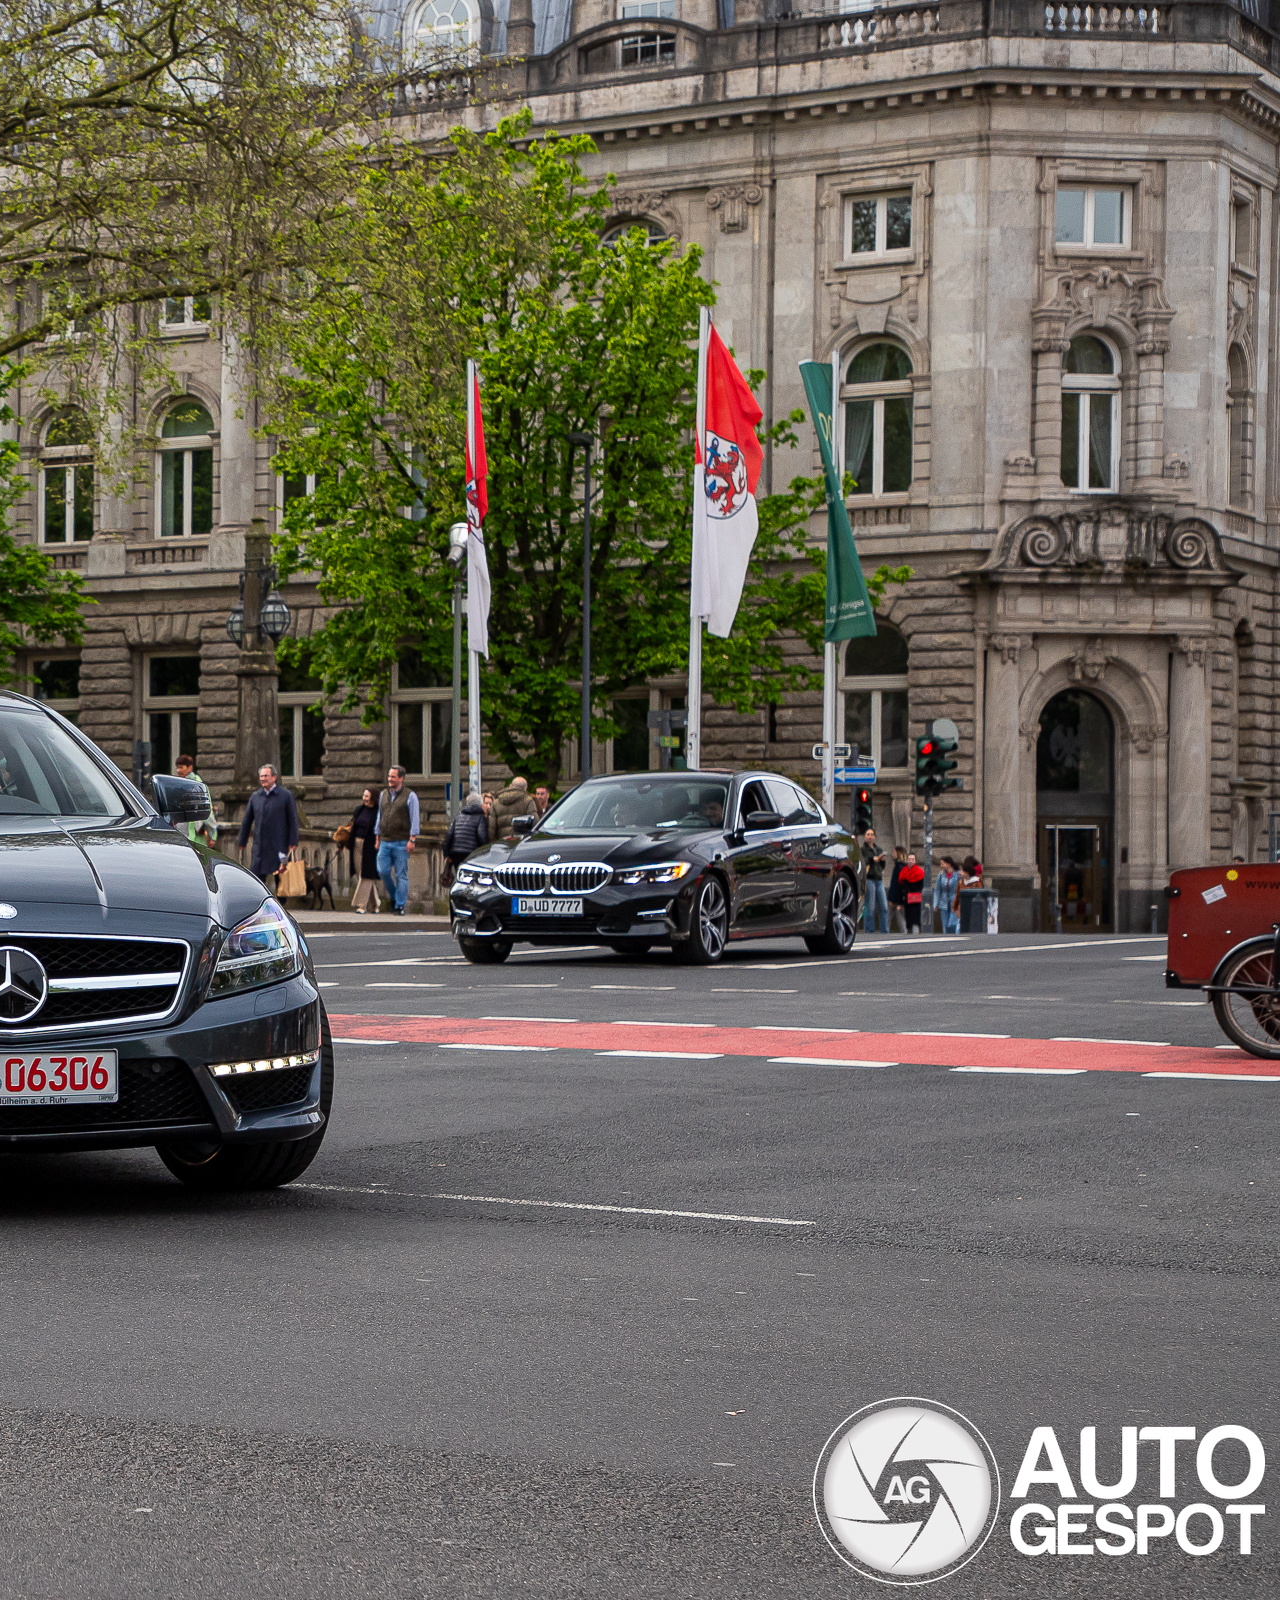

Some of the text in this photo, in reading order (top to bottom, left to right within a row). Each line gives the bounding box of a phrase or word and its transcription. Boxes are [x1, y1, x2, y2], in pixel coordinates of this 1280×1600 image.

[520, 900, 581, 912] D UD 7777
[4, 1056, 109, 1092] 06306
[40, 1096, 48, 1105] d.
[49, 1096, 68, 1104] Ruhr
